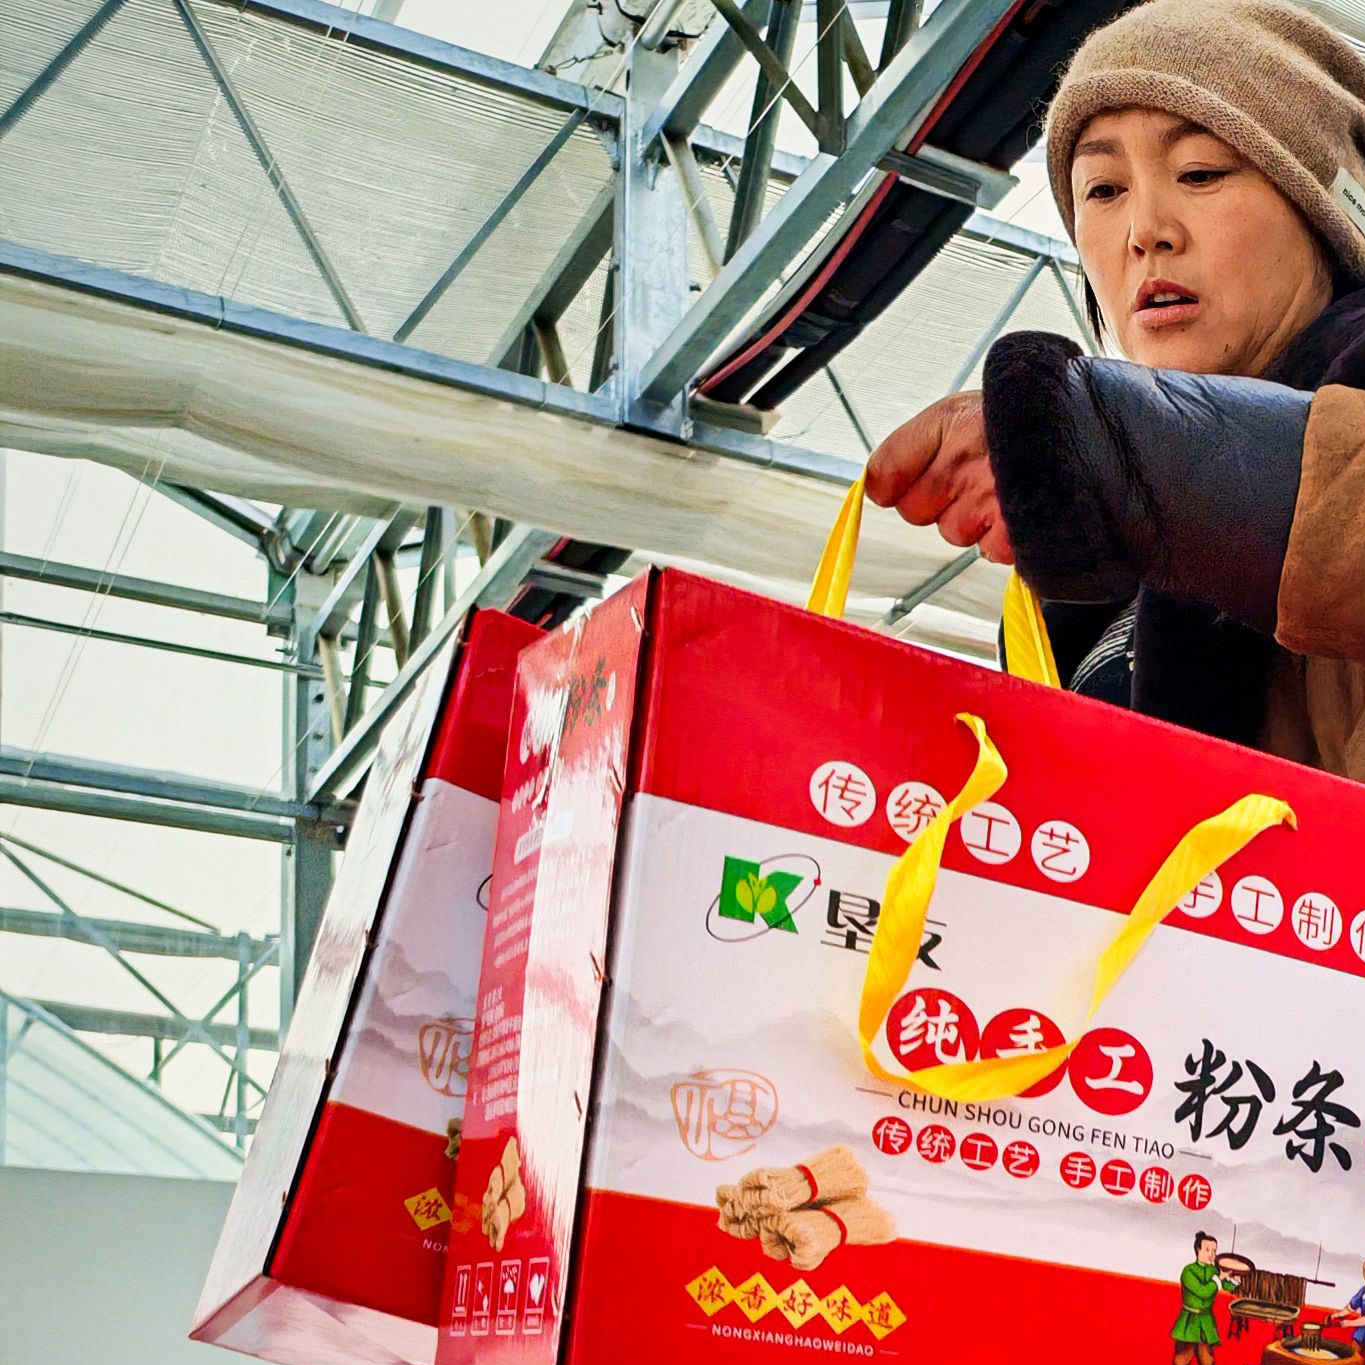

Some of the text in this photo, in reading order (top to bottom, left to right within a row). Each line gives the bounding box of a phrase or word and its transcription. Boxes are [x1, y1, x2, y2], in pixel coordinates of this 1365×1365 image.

[820, 772, 1081, 878] 传统工艺
[898, 1090, 1176, 1160] CHUN SHOU GONG FEN TIAO
[876, 1120, 1209, 1208] 传统工艺 手工制作
[697, 1277, 893, 1330] 浓香好味道
[711, 1323, 874, 1357] NONGXIANGHAOWEIDAO
